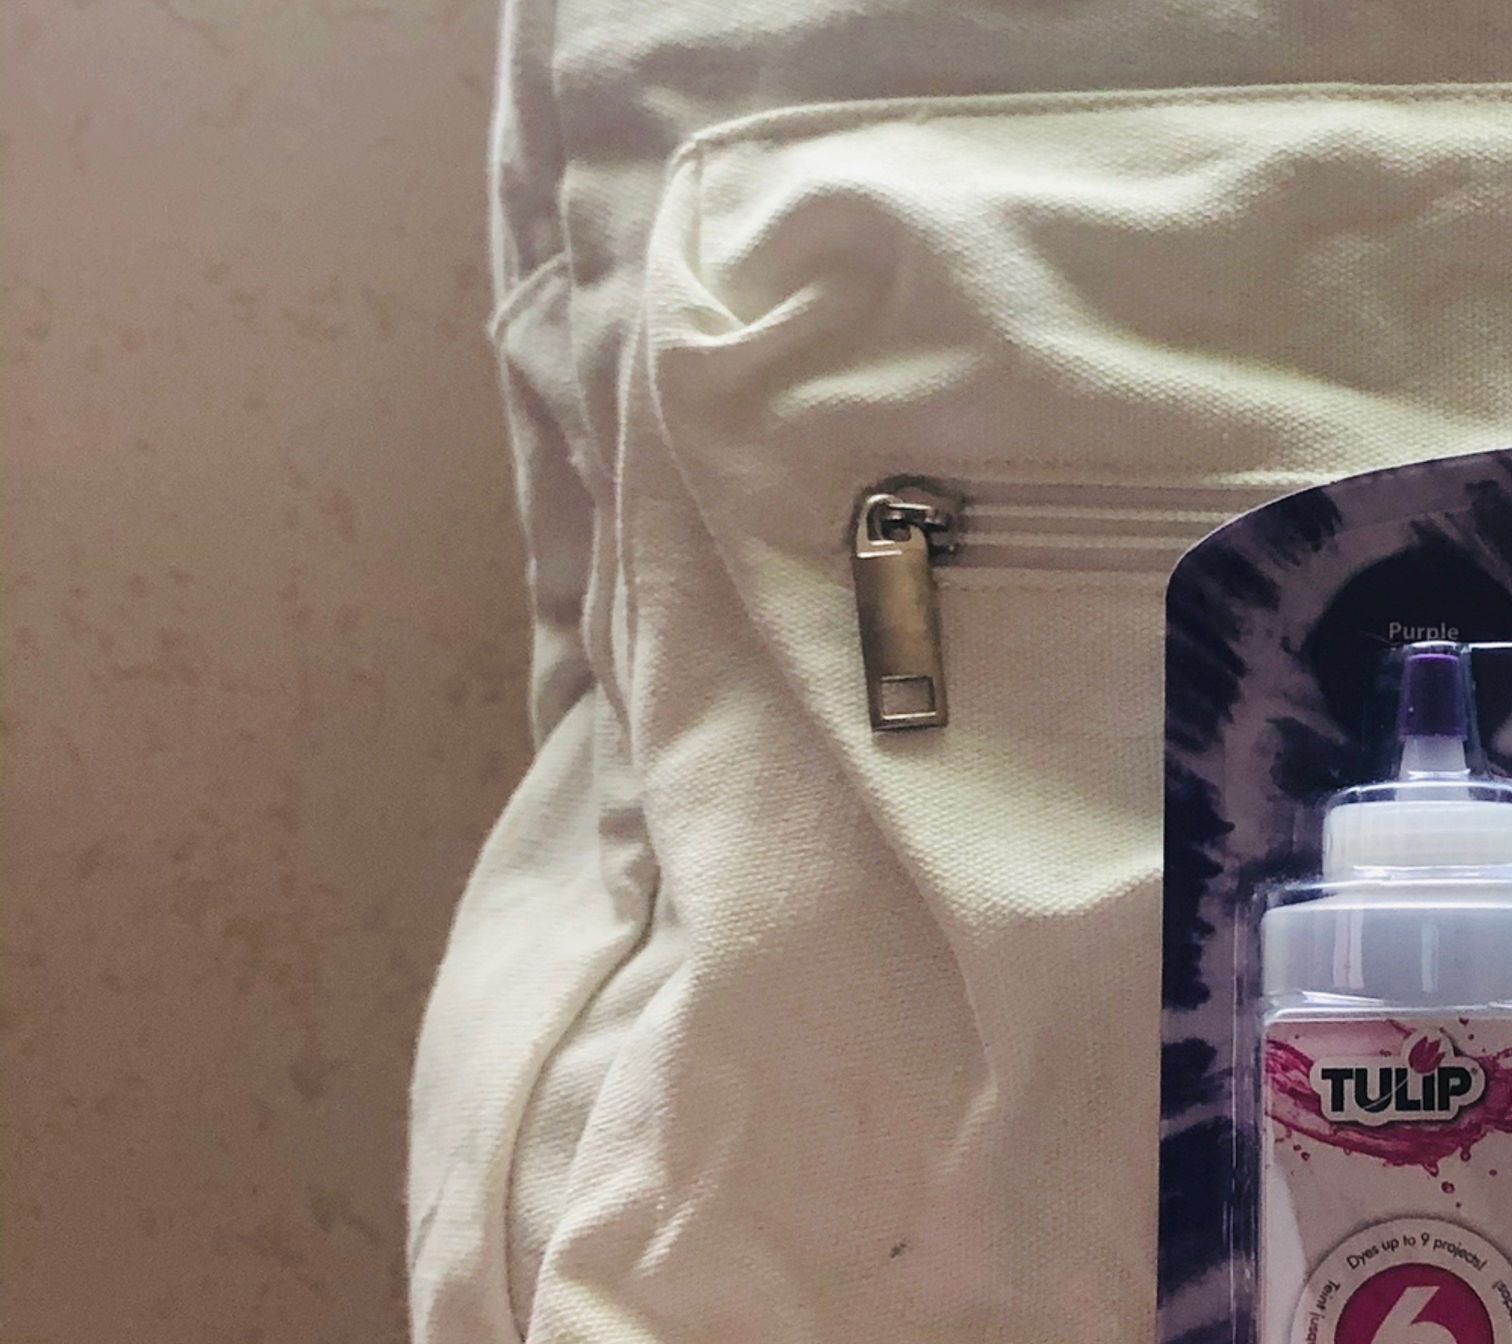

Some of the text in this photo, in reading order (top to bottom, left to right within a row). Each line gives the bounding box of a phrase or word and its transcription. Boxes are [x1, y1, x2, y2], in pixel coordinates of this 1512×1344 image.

[1389, 621, 1460, 642] Purple
[1346, 1232, 1488, 1273] Dyes up to 9 projects!
